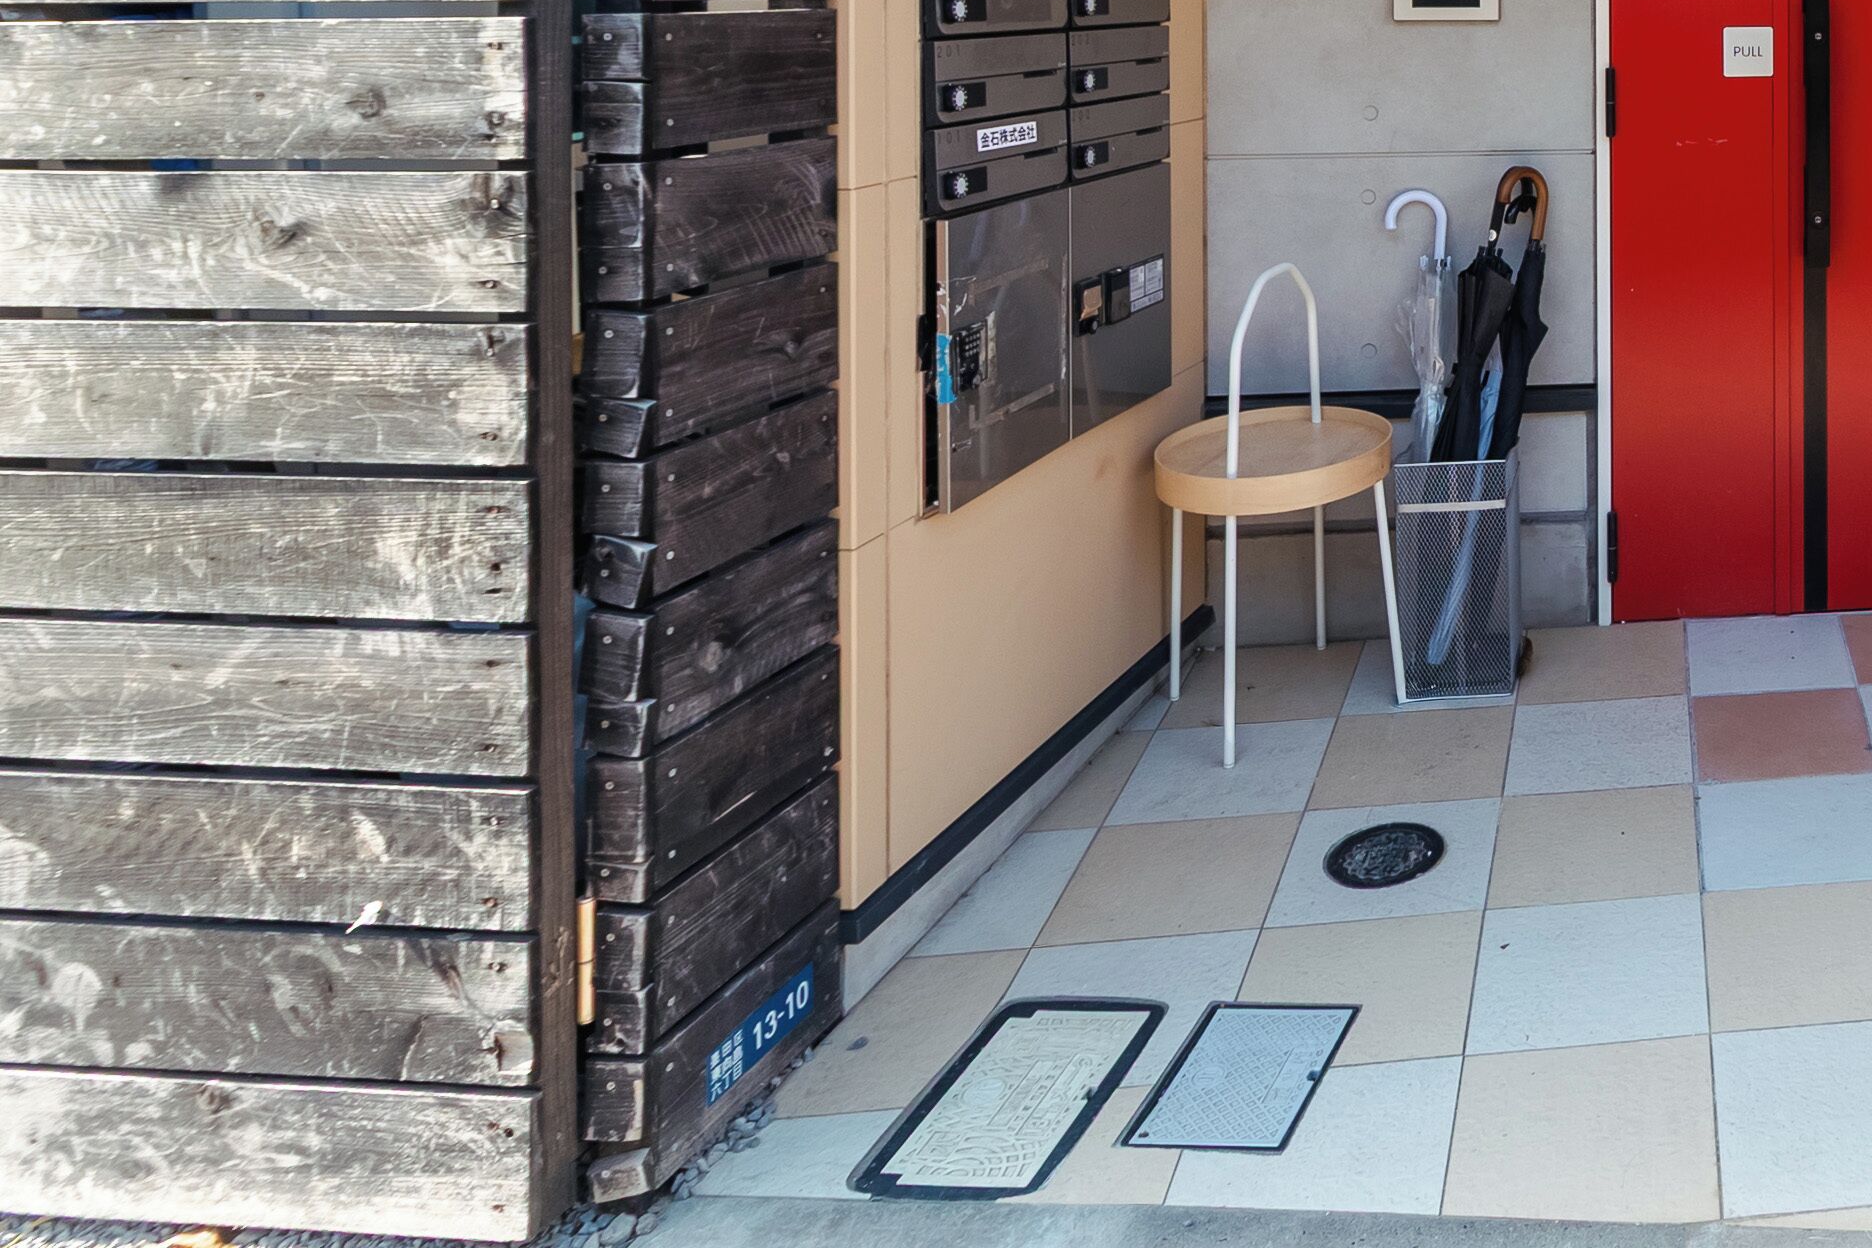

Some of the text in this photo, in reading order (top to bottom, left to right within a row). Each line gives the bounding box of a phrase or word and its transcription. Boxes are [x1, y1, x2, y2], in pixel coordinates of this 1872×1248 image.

[936, 43, 960, 58] 201
[1733, 45, 1764, 58] PULL
[752, 979, 809, 1050] 13-10
